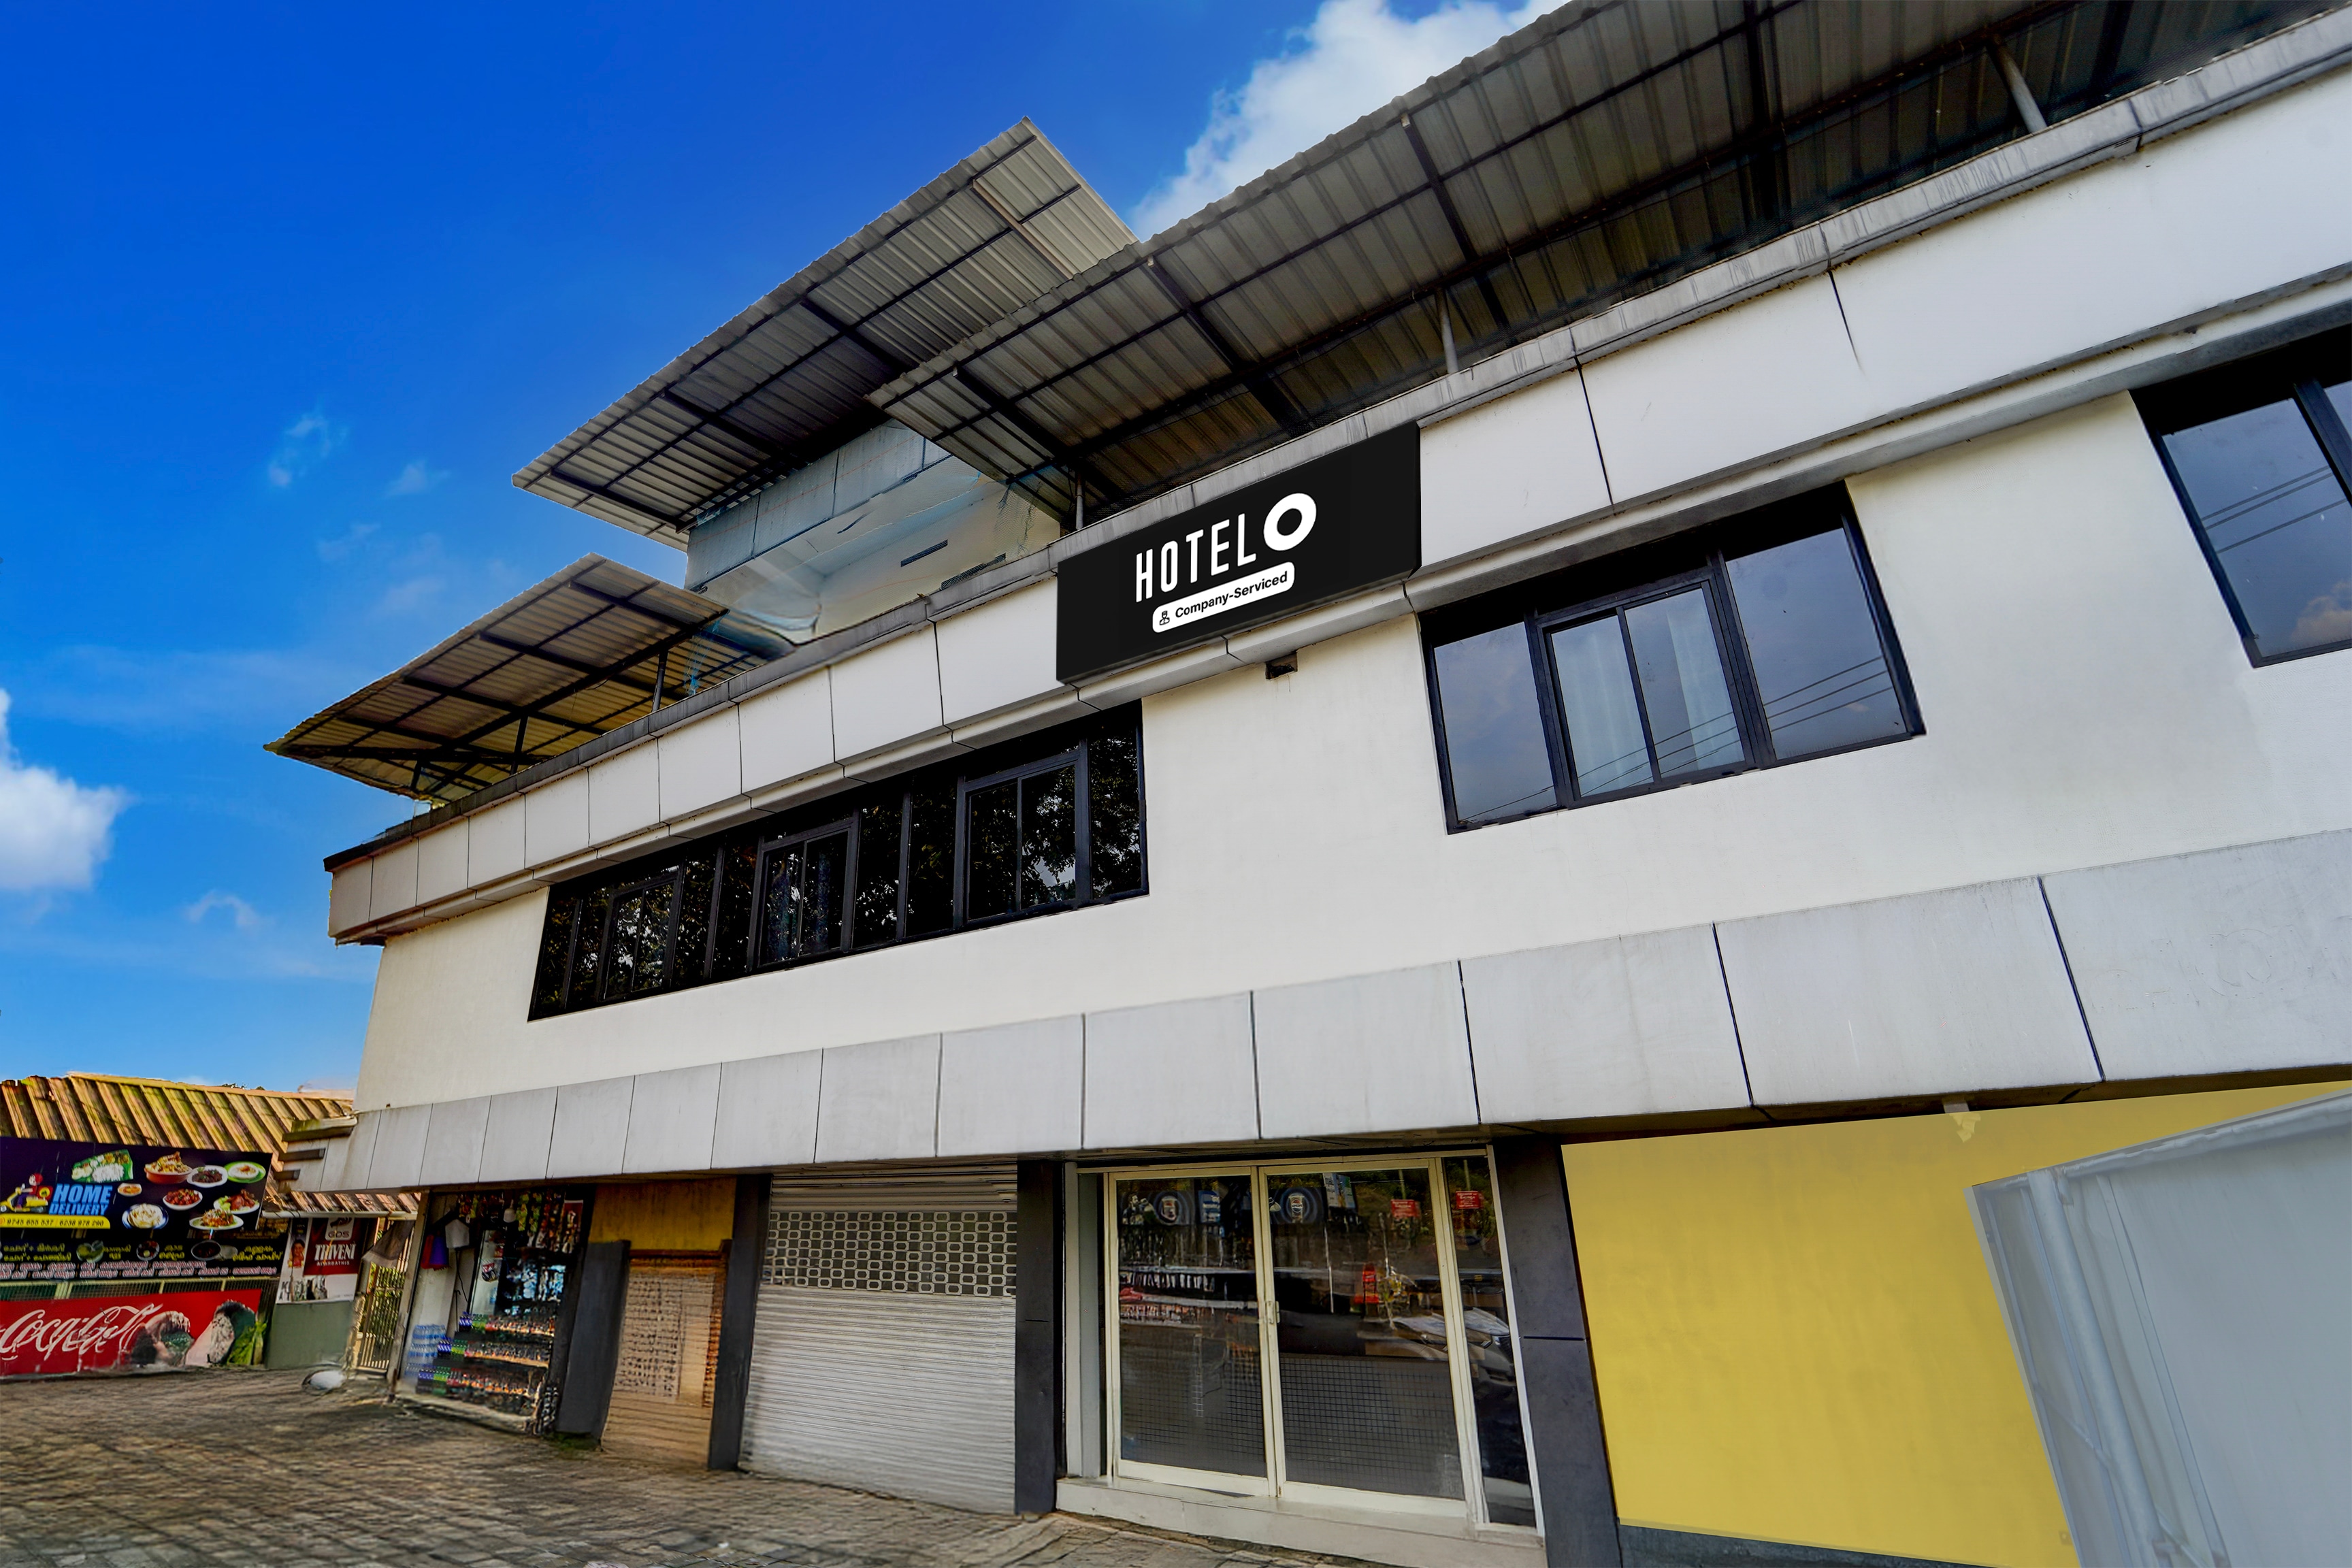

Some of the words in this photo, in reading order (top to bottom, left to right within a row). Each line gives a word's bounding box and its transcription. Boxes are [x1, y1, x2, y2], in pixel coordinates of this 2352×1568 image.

[1136, 514, 1256, 603] HOTEL
[1263, 493, 1318, 552] O
[1175, 570, 1288, 618] Company-Serviced
[48, 1203, 108, 1215] DELIVERY
[53, 1183, 113, 1204] HOME
